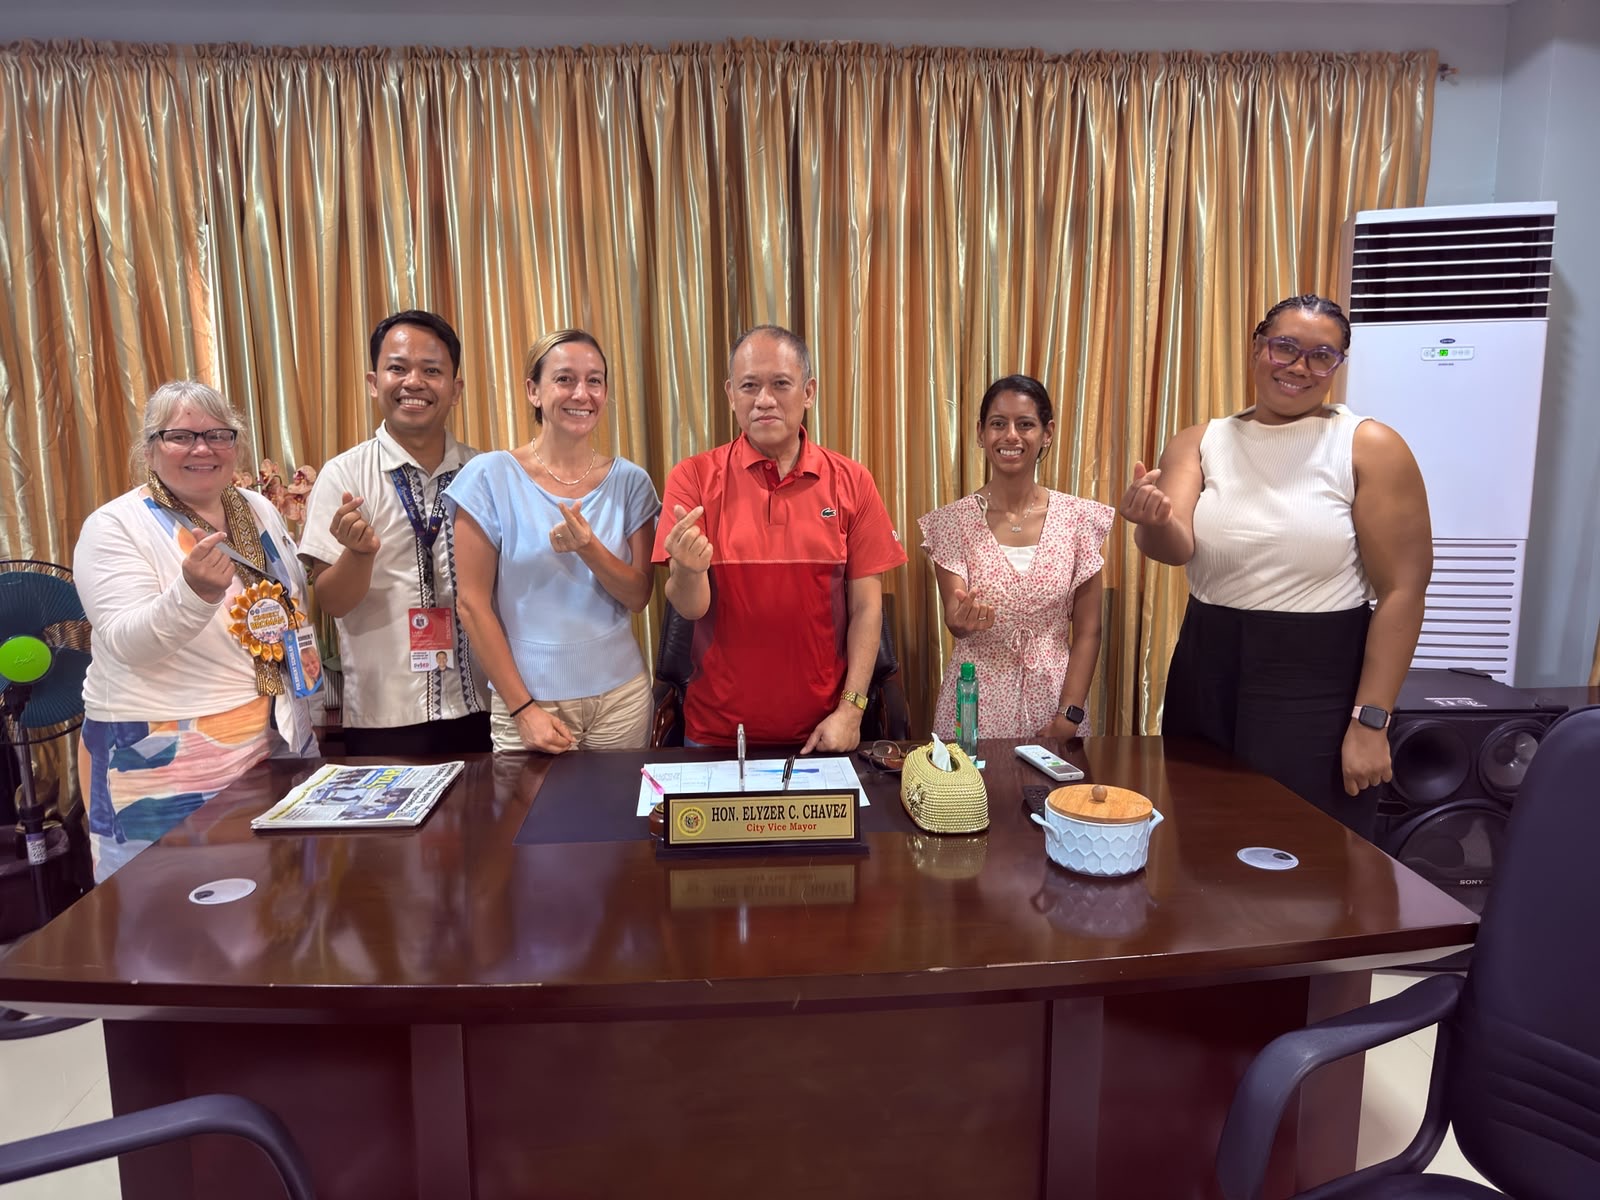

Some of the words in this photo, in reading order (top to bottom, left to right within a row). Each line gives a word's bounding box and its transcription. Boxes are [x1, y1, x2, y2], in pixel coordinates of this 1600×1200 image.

[711, 806, 739, 822] HON.
[742, 804, 785, 821] ELYZER
[788, 806, 799, 820] C.
[802, 803, 848, 820] CHAVEZ
[746, 823, 765, 833] City
[767, 823, 787, 832] Vice
[789, 822, 817, 833] Mayor
